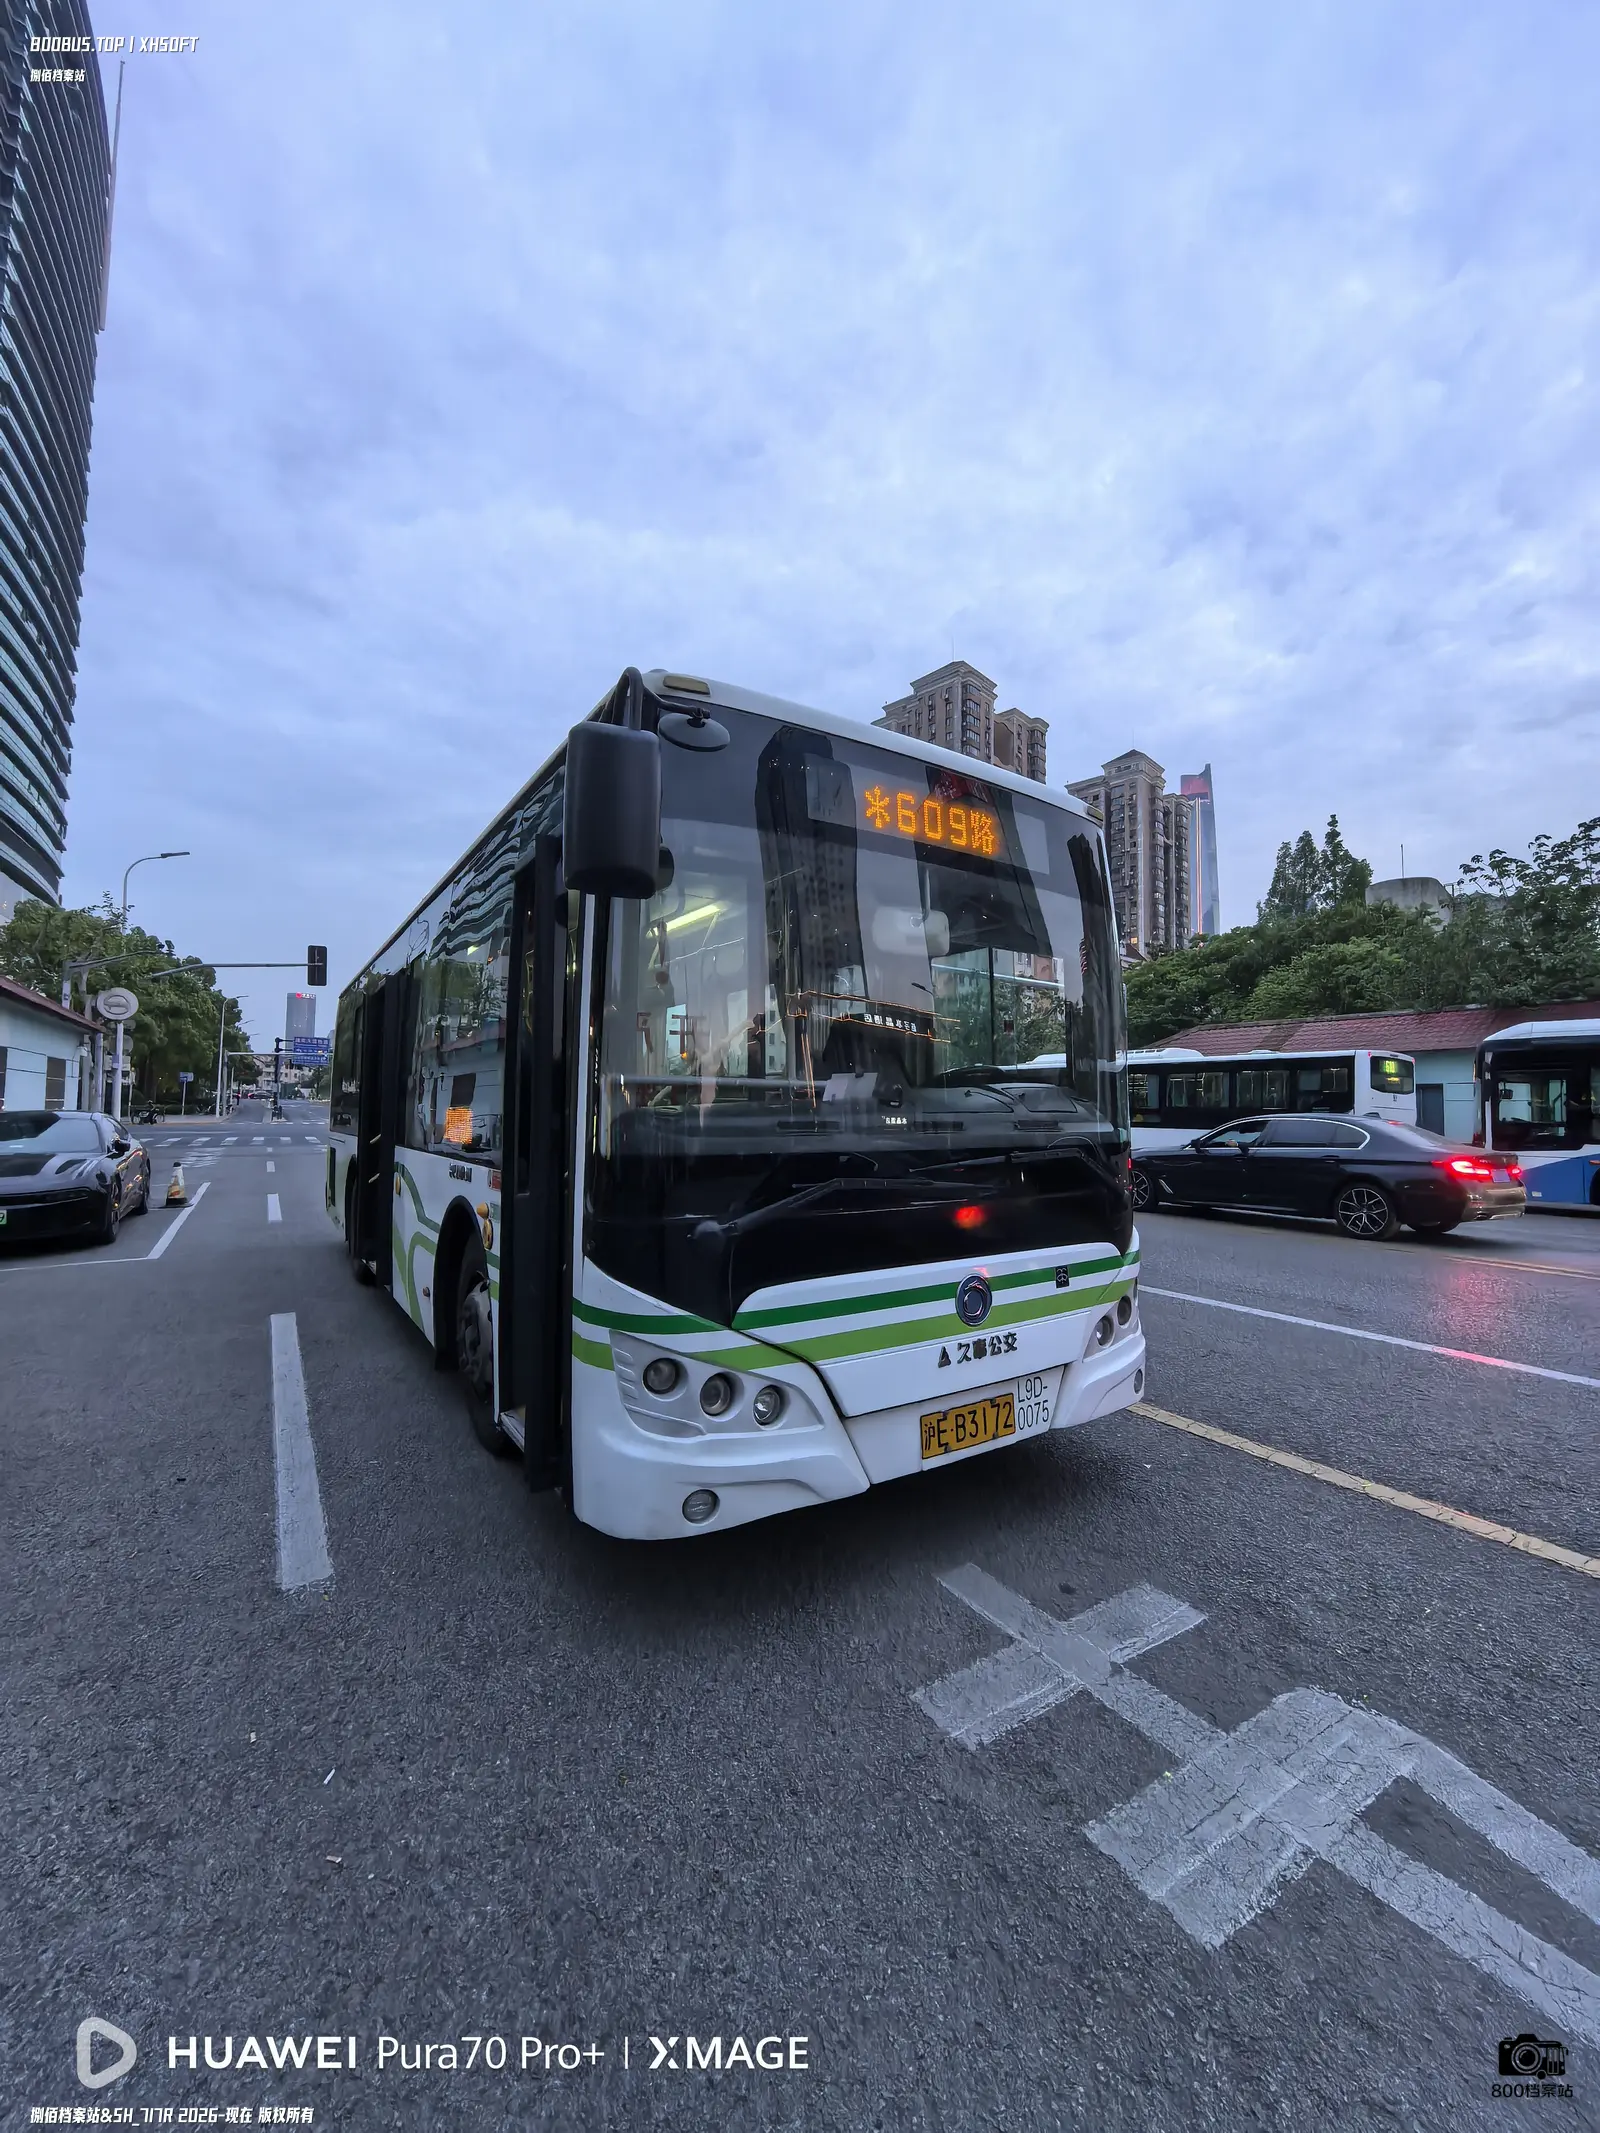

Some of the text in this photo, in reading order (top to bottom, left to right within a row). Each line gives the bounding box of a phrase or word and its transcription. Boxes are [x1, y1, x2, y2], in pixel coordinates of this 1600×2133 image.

[957, 1331, 1018, 1364] 久事公交
[1016, 1375, 1048, 1404] L9D-
[1017, 1399, 1050, 1431] 0075
